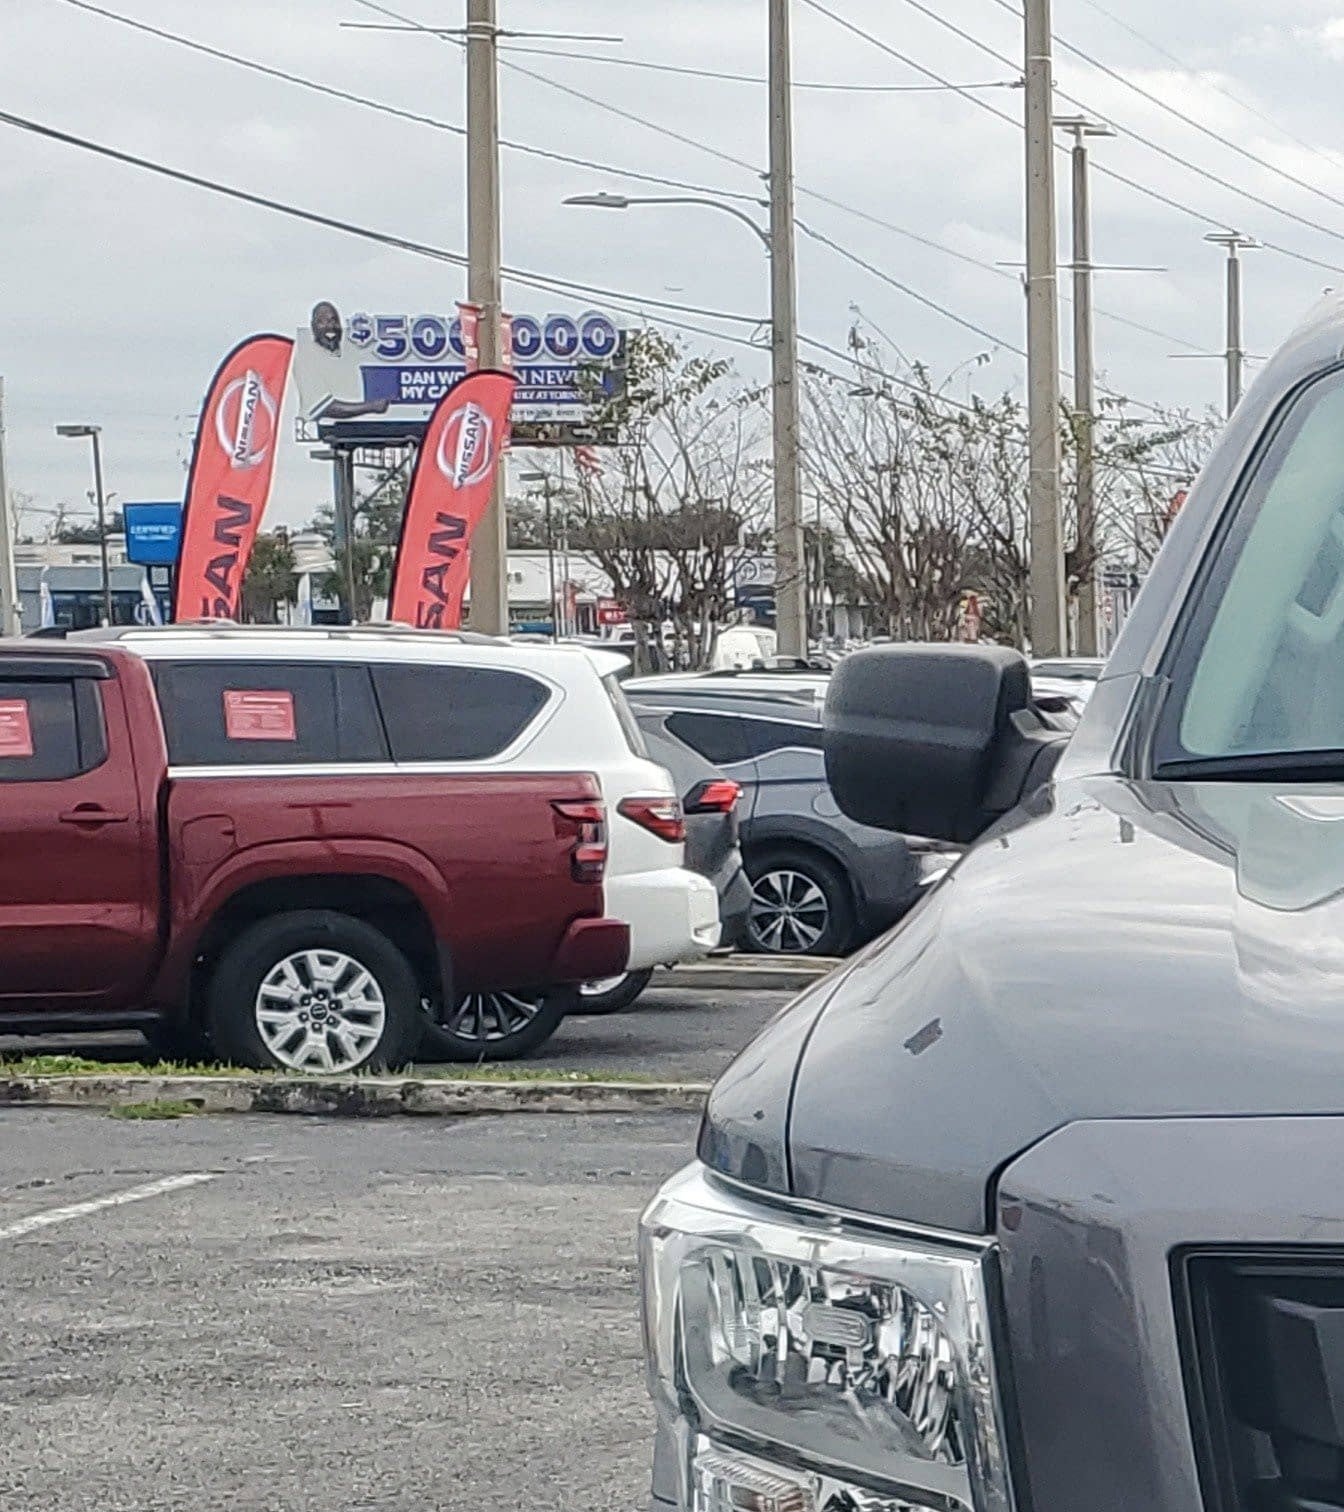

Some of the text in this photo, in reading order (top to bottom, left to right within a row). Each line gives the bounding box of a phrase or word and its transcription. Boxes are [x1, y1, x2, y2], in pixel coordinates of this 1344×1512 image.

[400, 371, 435, 385] DAN
[401, 386, 425, 399] MY
[457, 410, 481, 485] NISSAN
